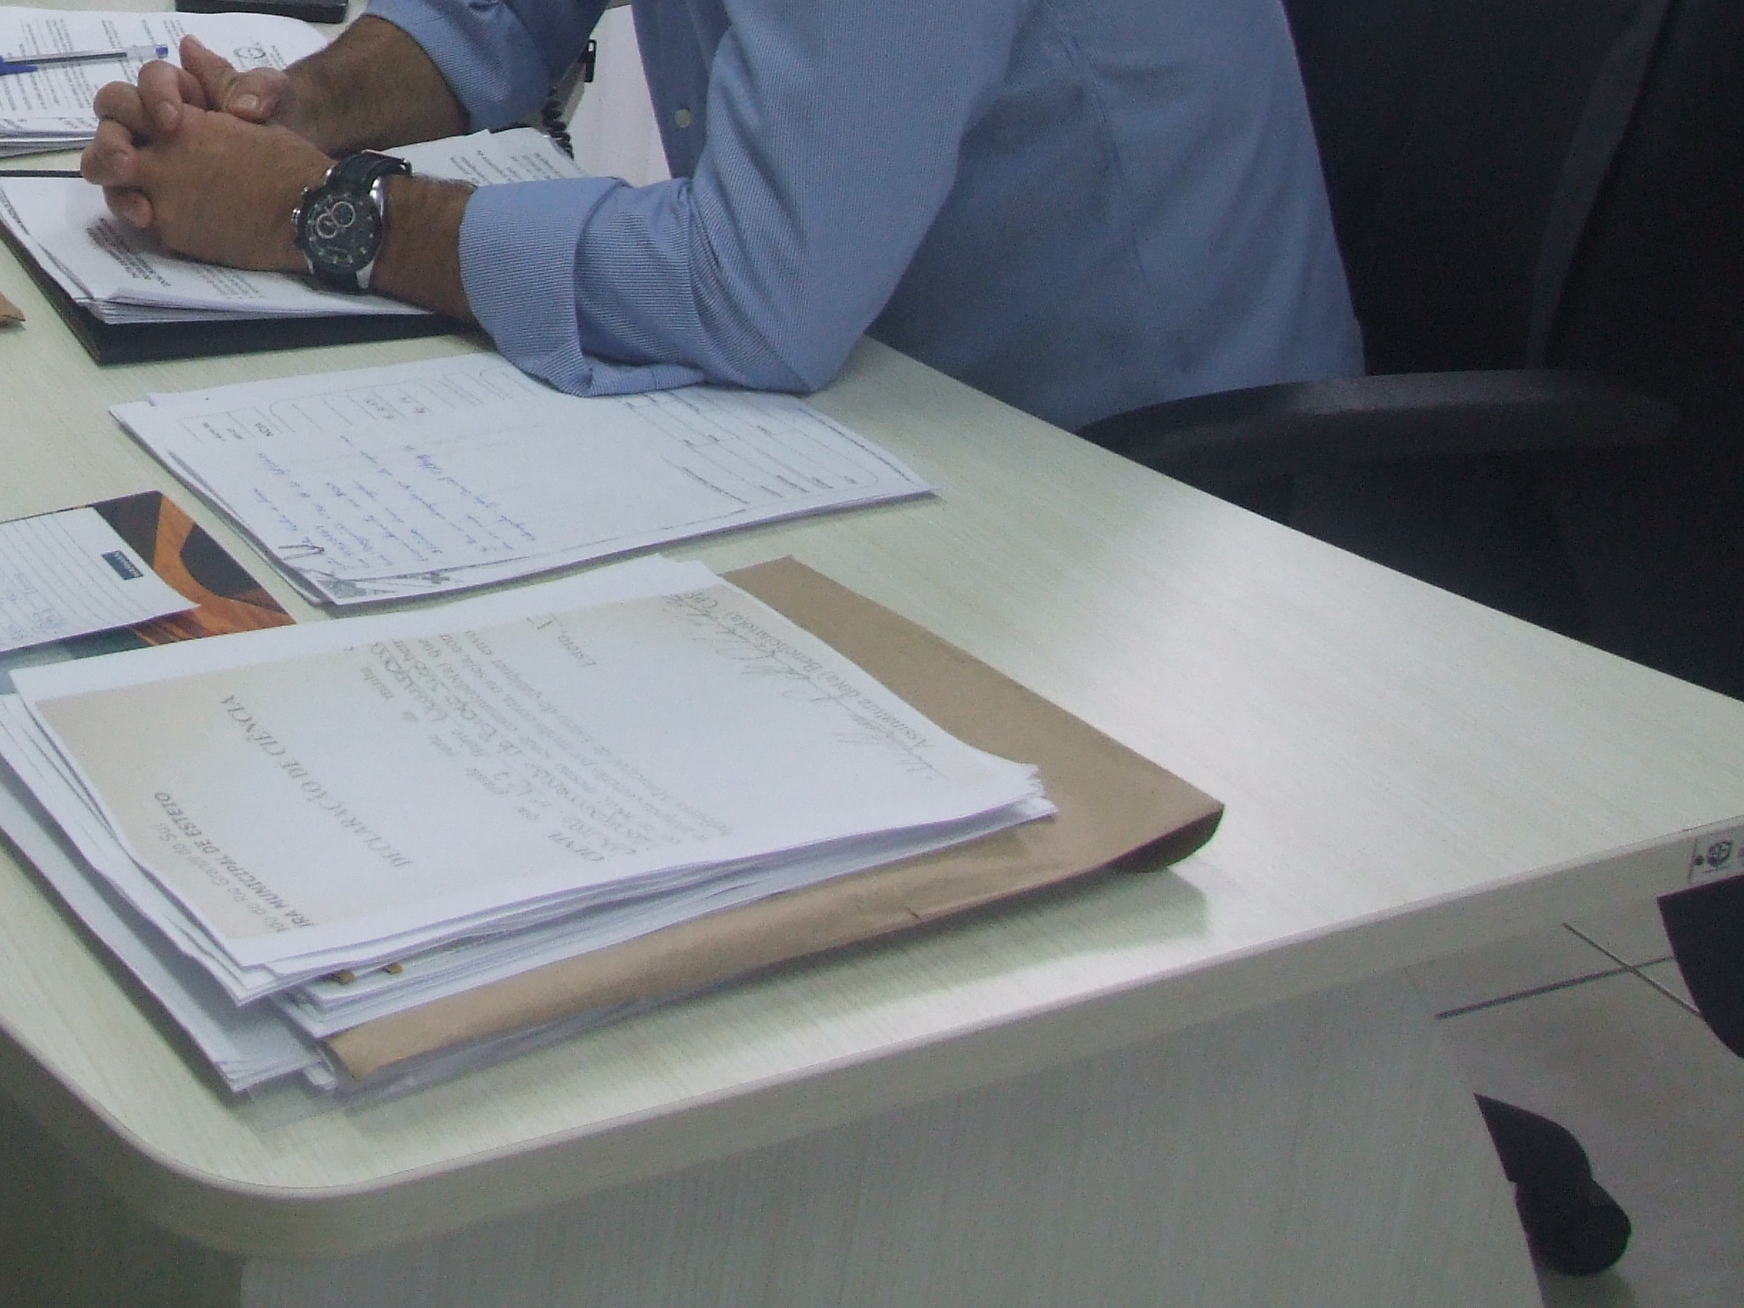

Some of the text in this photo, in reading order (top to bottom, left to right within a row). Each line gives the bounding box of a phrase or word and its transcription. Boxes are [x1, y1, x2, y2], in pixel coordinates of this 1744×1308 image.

[417, 638, 442, 658] que
[724, 612, 824, 673] Beneficiário(a)
[820, 670, 862, 698] do(a)
[857, 697, 935, 749] Assinatura
[219, 694, 414, 868] DECLARAÇÃO DE CIÊNCIA
[150, 823, 178, 842] Sul
[153, 791, 203, 838] ESTEIO
[193, 838, 221, 854] DE
[219, 854, 288, 909] MUNICIPAL
